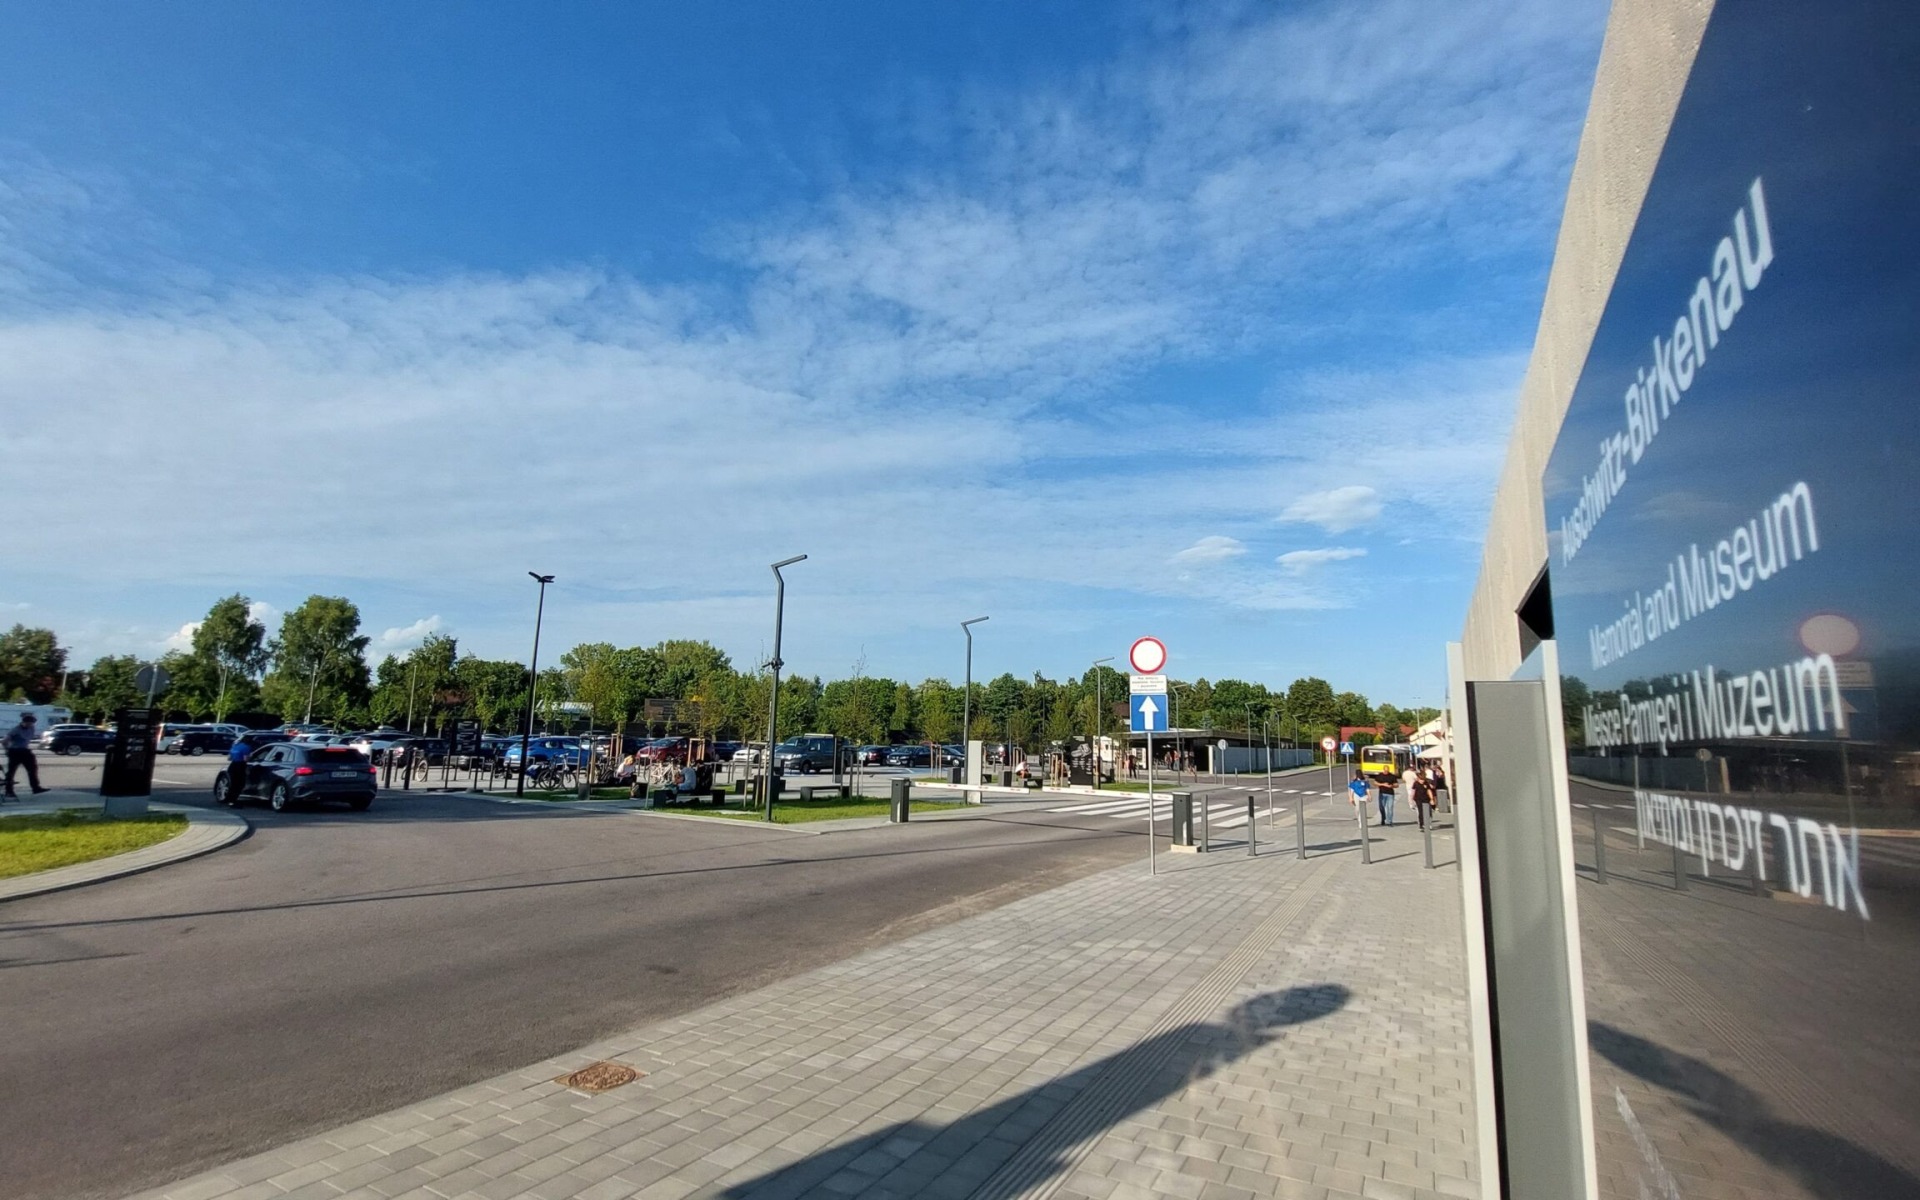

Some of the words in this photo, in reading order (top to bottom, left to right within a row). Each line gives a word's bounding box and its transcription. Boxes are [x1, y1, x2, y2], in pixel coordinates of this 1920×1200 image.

[1561, 176, 1774, 568] Auschwitz-Birkenau
[1589, 591, 1645, 671] Memorial
[1645, 563, 1680, 642] and
[1678, 481, 1818, 621] Museum
[1582, 693, 1622, 757] Miejsce
[1620, 676, 1684, 757] Pamięci
[1683, 673, 1694, 740] i
[1693, 653, 1844, 739] Muzeum
[1694, 800, 1766, 881] זיכרון
[1769, 813, 1871, 921] אתר
